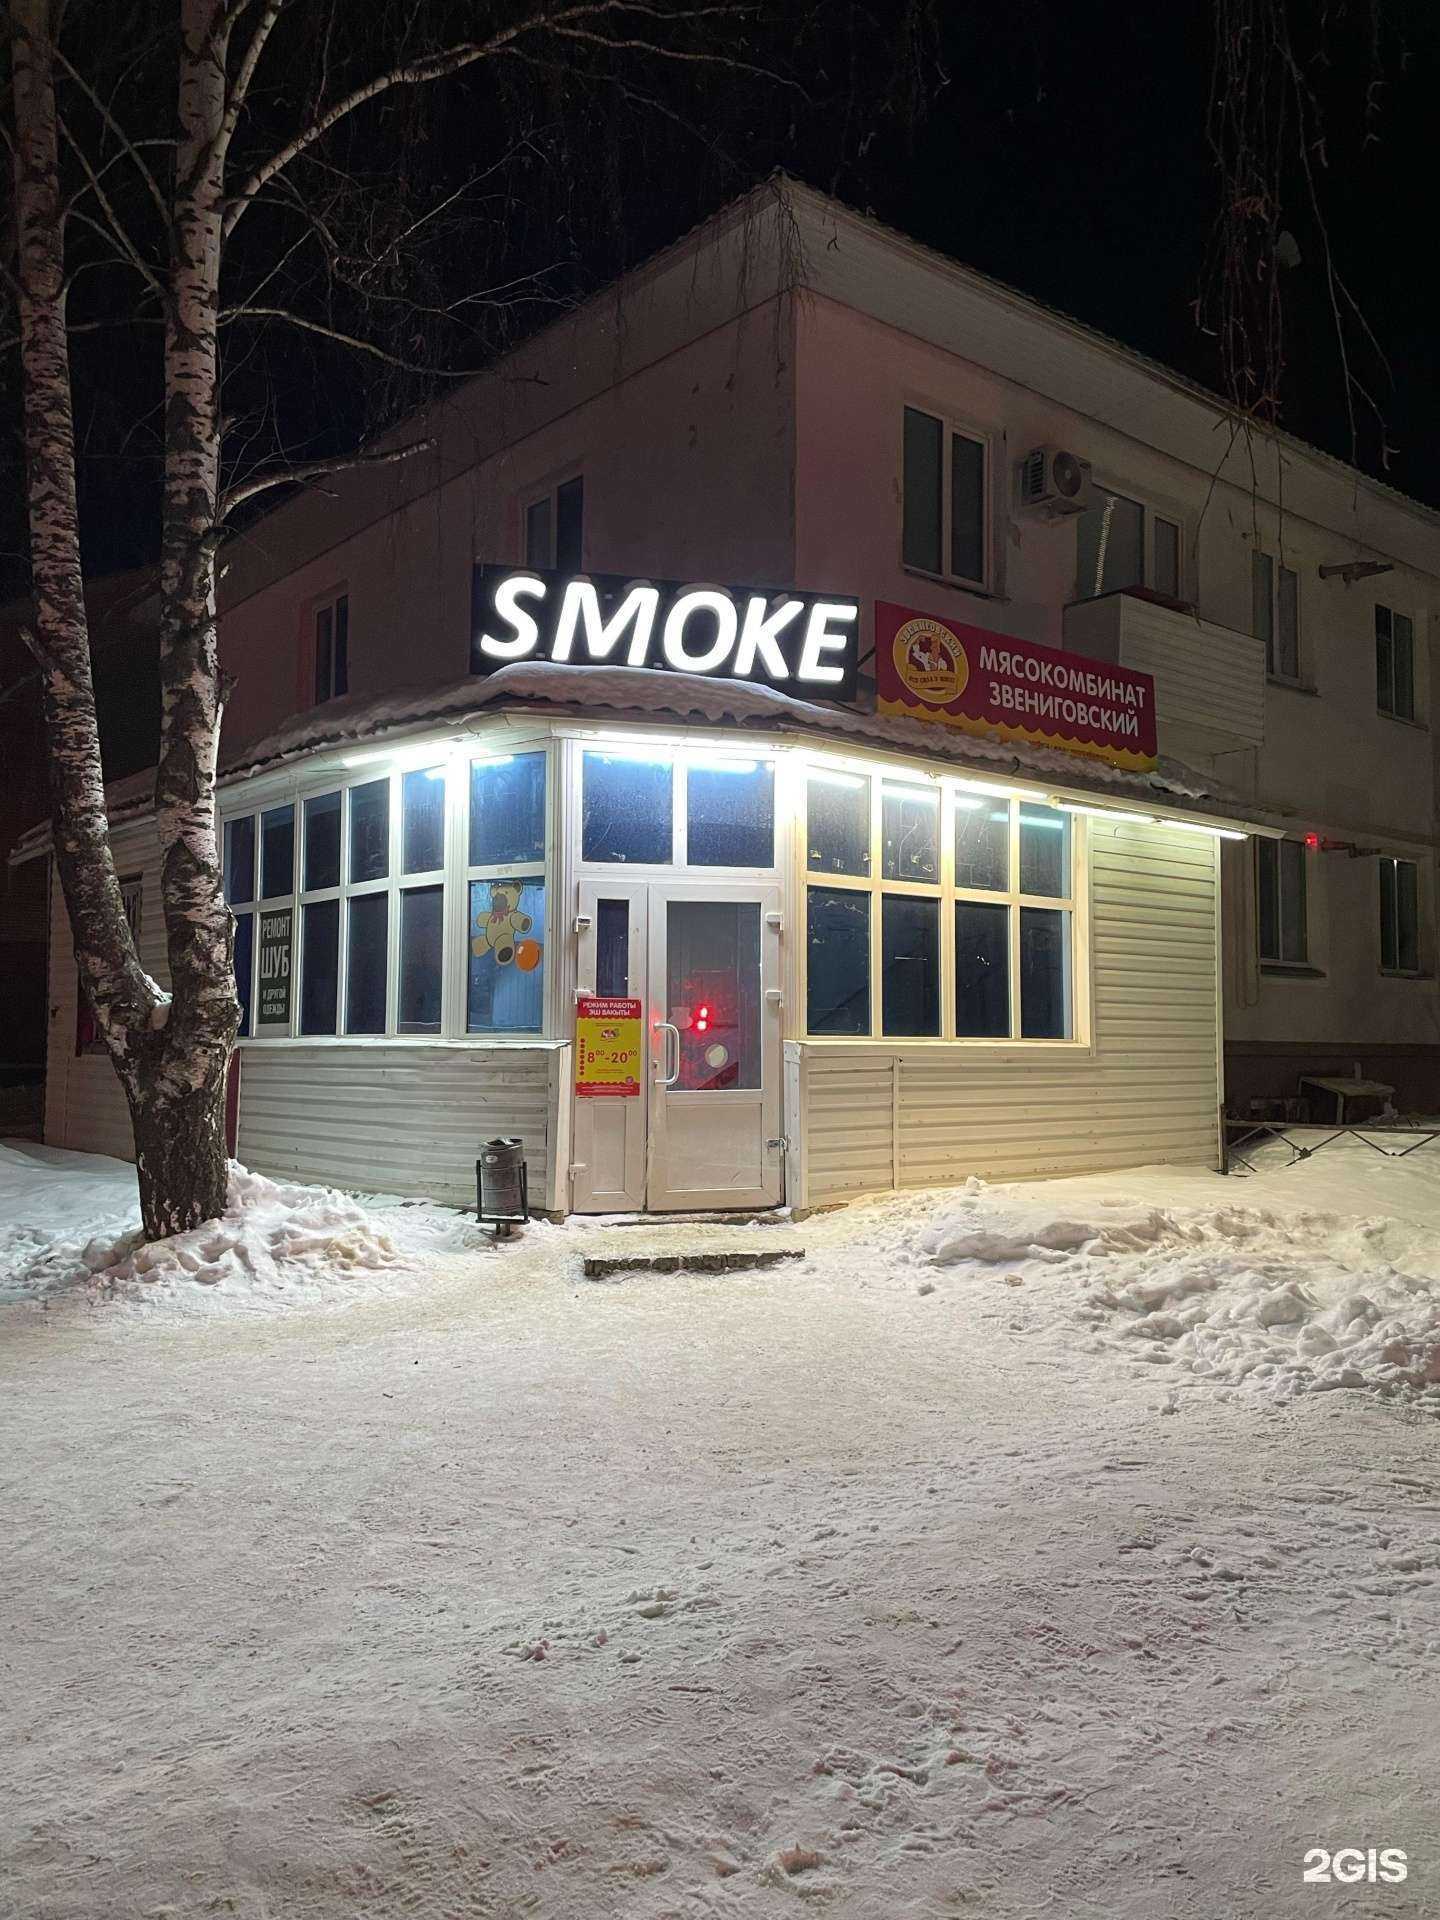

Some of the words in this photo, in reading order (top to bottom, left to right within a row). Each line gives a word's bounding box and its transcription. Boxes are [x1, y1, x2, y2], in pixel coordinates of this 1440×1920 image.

[480, 576, 858, 683] SMOKE
[979, 646, 1146, 708] МЯСОКОМБИНАТ
[989, 682, 1139, 737] ЗВЕНИГОВСКИЙ
[262, 916, 291, 939] РЕМОНТ
[261, 945, 289, 979] ШУБ
